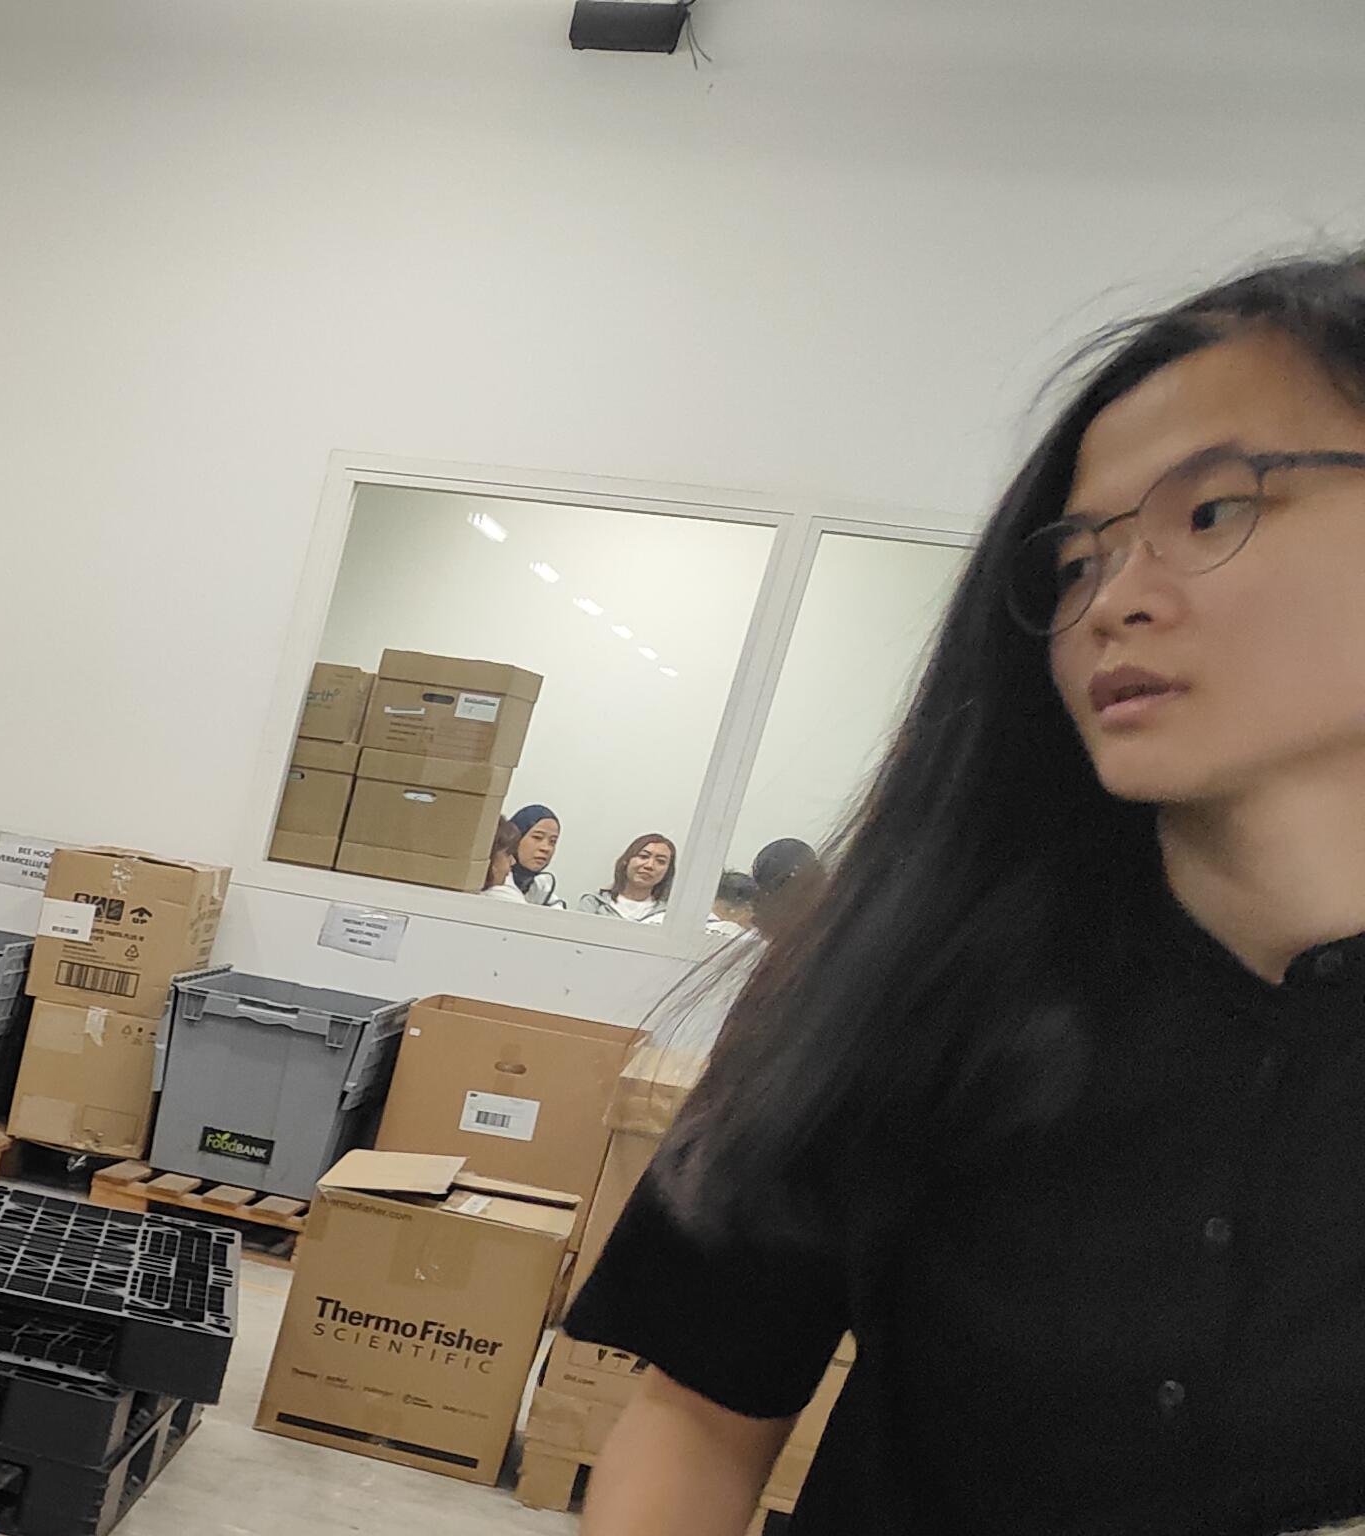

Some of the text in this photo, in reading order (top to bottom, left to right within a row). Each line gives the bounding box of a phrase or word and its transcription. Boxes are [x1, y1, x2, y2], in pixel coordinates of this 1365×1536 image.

[18, 847, 53, 858] BEE HOO
[313, 1323, 493, 1374] SCIENTIFIC
